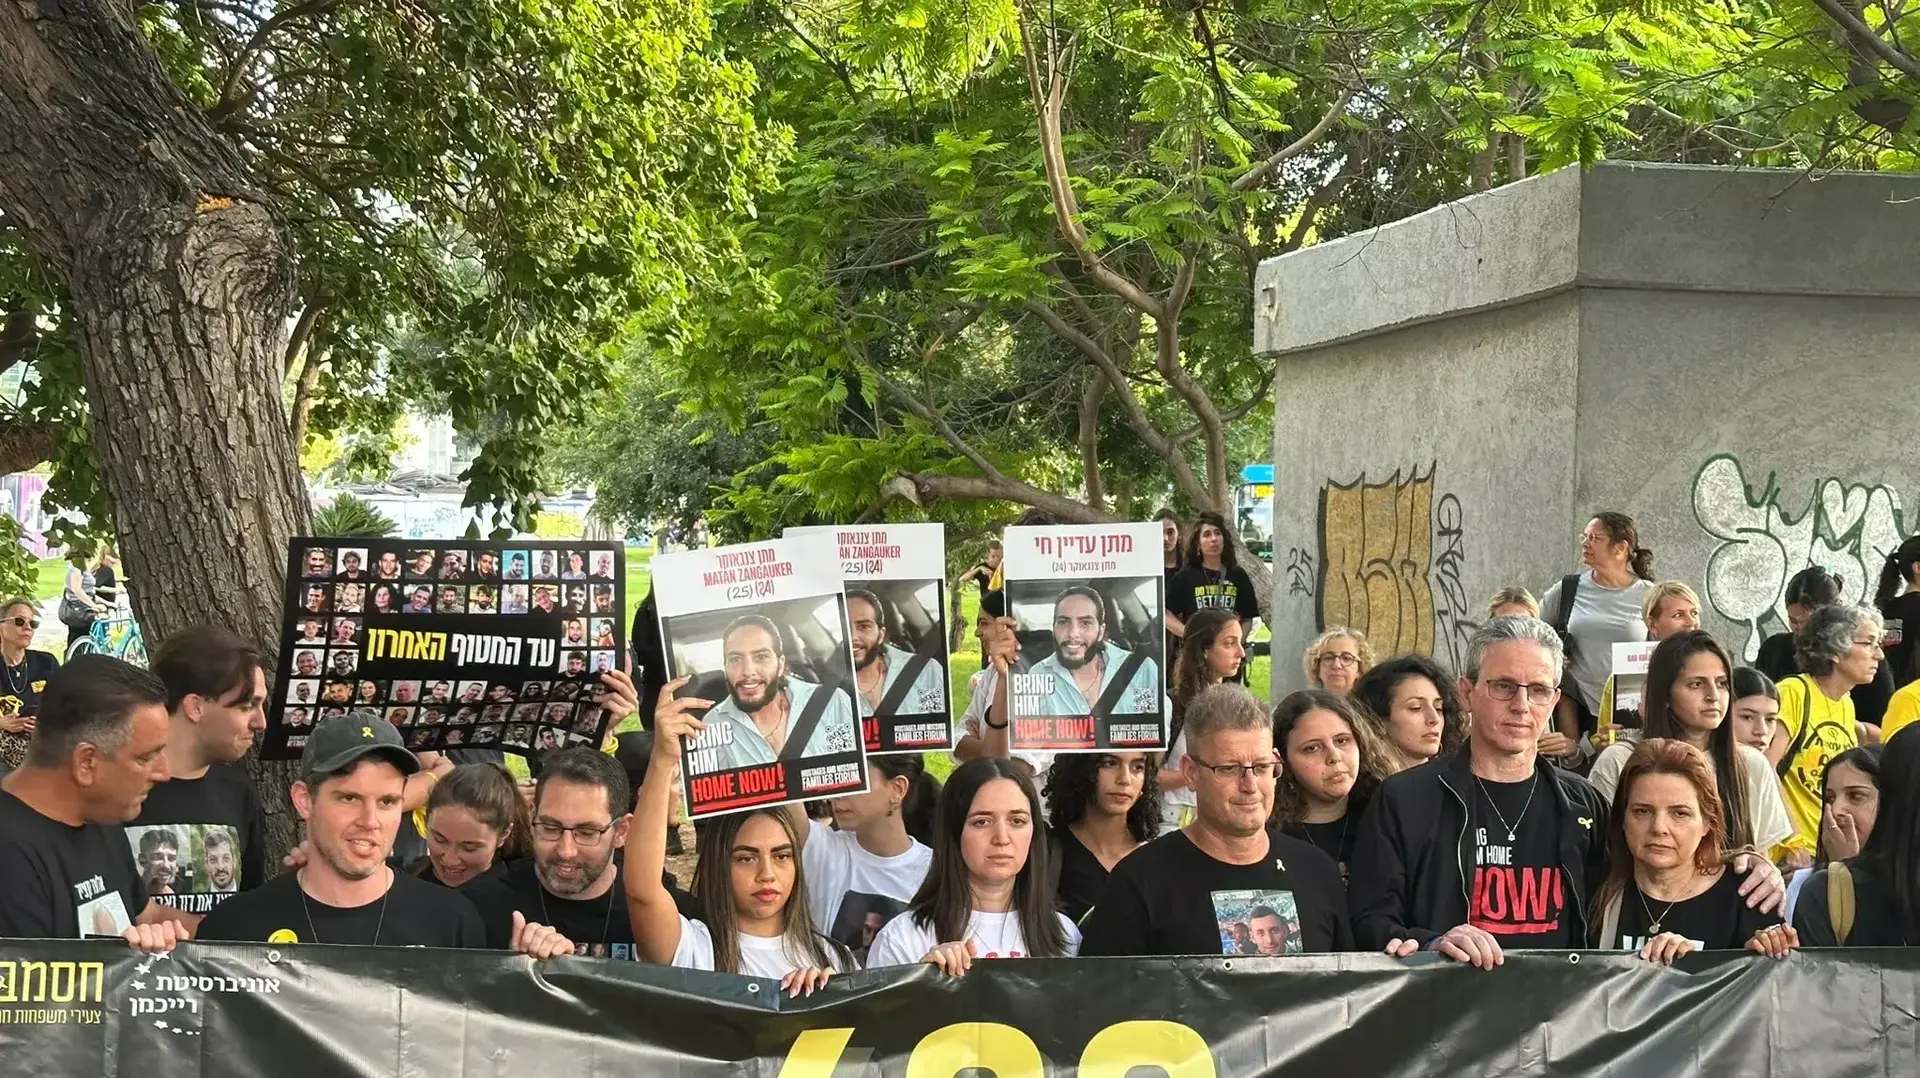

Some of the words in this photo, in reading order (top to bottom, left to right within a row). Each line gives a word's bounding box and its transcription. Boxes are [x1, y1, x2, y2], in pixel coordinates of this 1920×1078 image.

[871, 531, 887, 546] מתן
[1034, 537, 1052, 555] חי
[1056, 535, 1096, 558] עדיין
[1101, 534, 1133, 557] מתן
[716, 551, 756, 569] צנגאוקר
[757, 548, 776, 565] מתן
[852, 546, 901, 559] ZANGAUKER
[703, 569, 737, 587] MATAN
[738, 562, 794, 582] ZANGAUKER
[1068, 562, 1099, 573] צנגאוקר
[1101, 561, 1116, 572] מתן
[727, 584, 753, 601] (25)
[366, 628, 448, 661] האחרון
[451, 633, 522, 667] החטוף
[526, 637, 556, 667] עד
[1013, 673, 1055, 695] BRING
[1014, 695, 1040, 716] HIM
[894, 730, 923, 743] FAMILIES
[924, 729, 947, 741] FORUM
[1014, 718, 1052, 739] HOME
[1056, 716, 1095, 739] NOW!
[1110, 731, 1137, 742] FAMILIES
[1137, 730, 1160, 741] FORUM
[687, 749, 719, 776] HIM
[691, 773, 736, 802] HOME
[739, 762, 786, 796] NOW!
[802, 772, 833, 790] FAMILIES
[834, 770, 860, 784] FORUM
[1486, 845, 1513, 865] HOME
[156, 975, 281, 994] אוניברסיטת
[14, 1010, 67, 1024] משפחות
[70, 1009, 102, 1024] צעירי
[129, 997, 198, 1017] רייכמן
